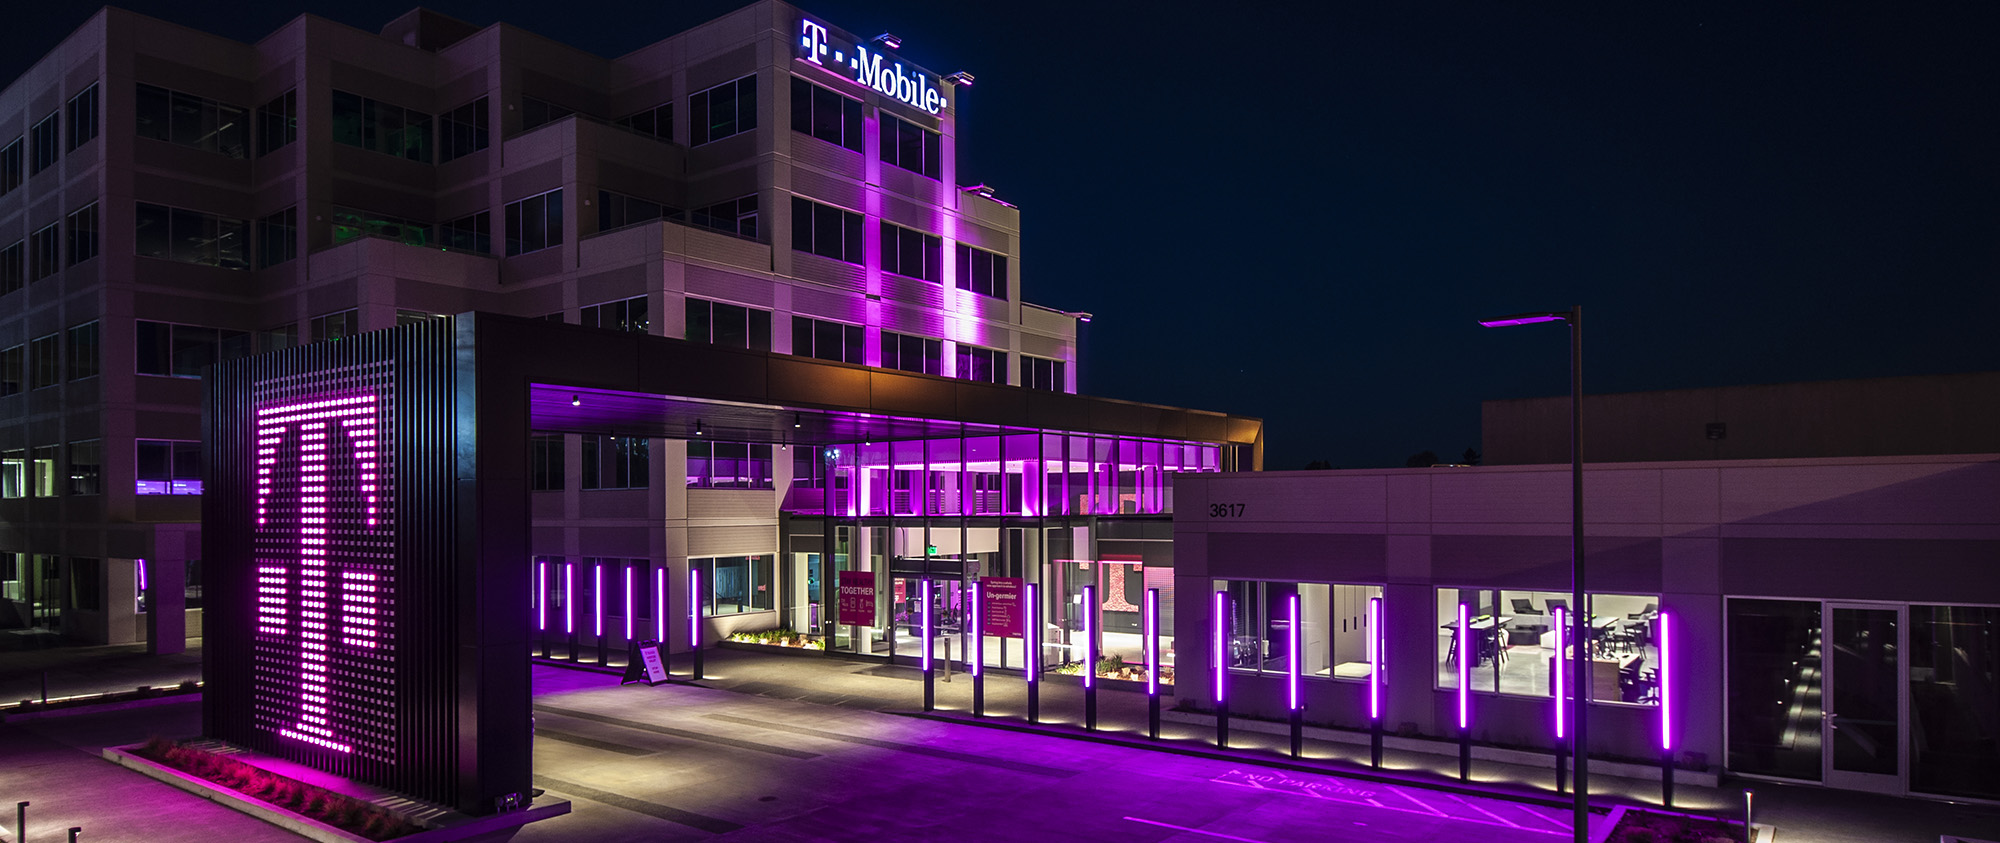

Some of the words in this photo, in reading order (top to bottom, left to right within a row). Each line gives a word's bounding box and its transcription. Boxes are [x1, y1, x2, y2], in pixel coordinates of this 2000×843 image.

[1209, 503, 1246, 518] 3617
[258, 394, 377, 753] T
[840, 586, 874, 596] TOGETHER
[1242, 774, 1274, 783] NO
[1278, 778, 1377, 798] PARKING
